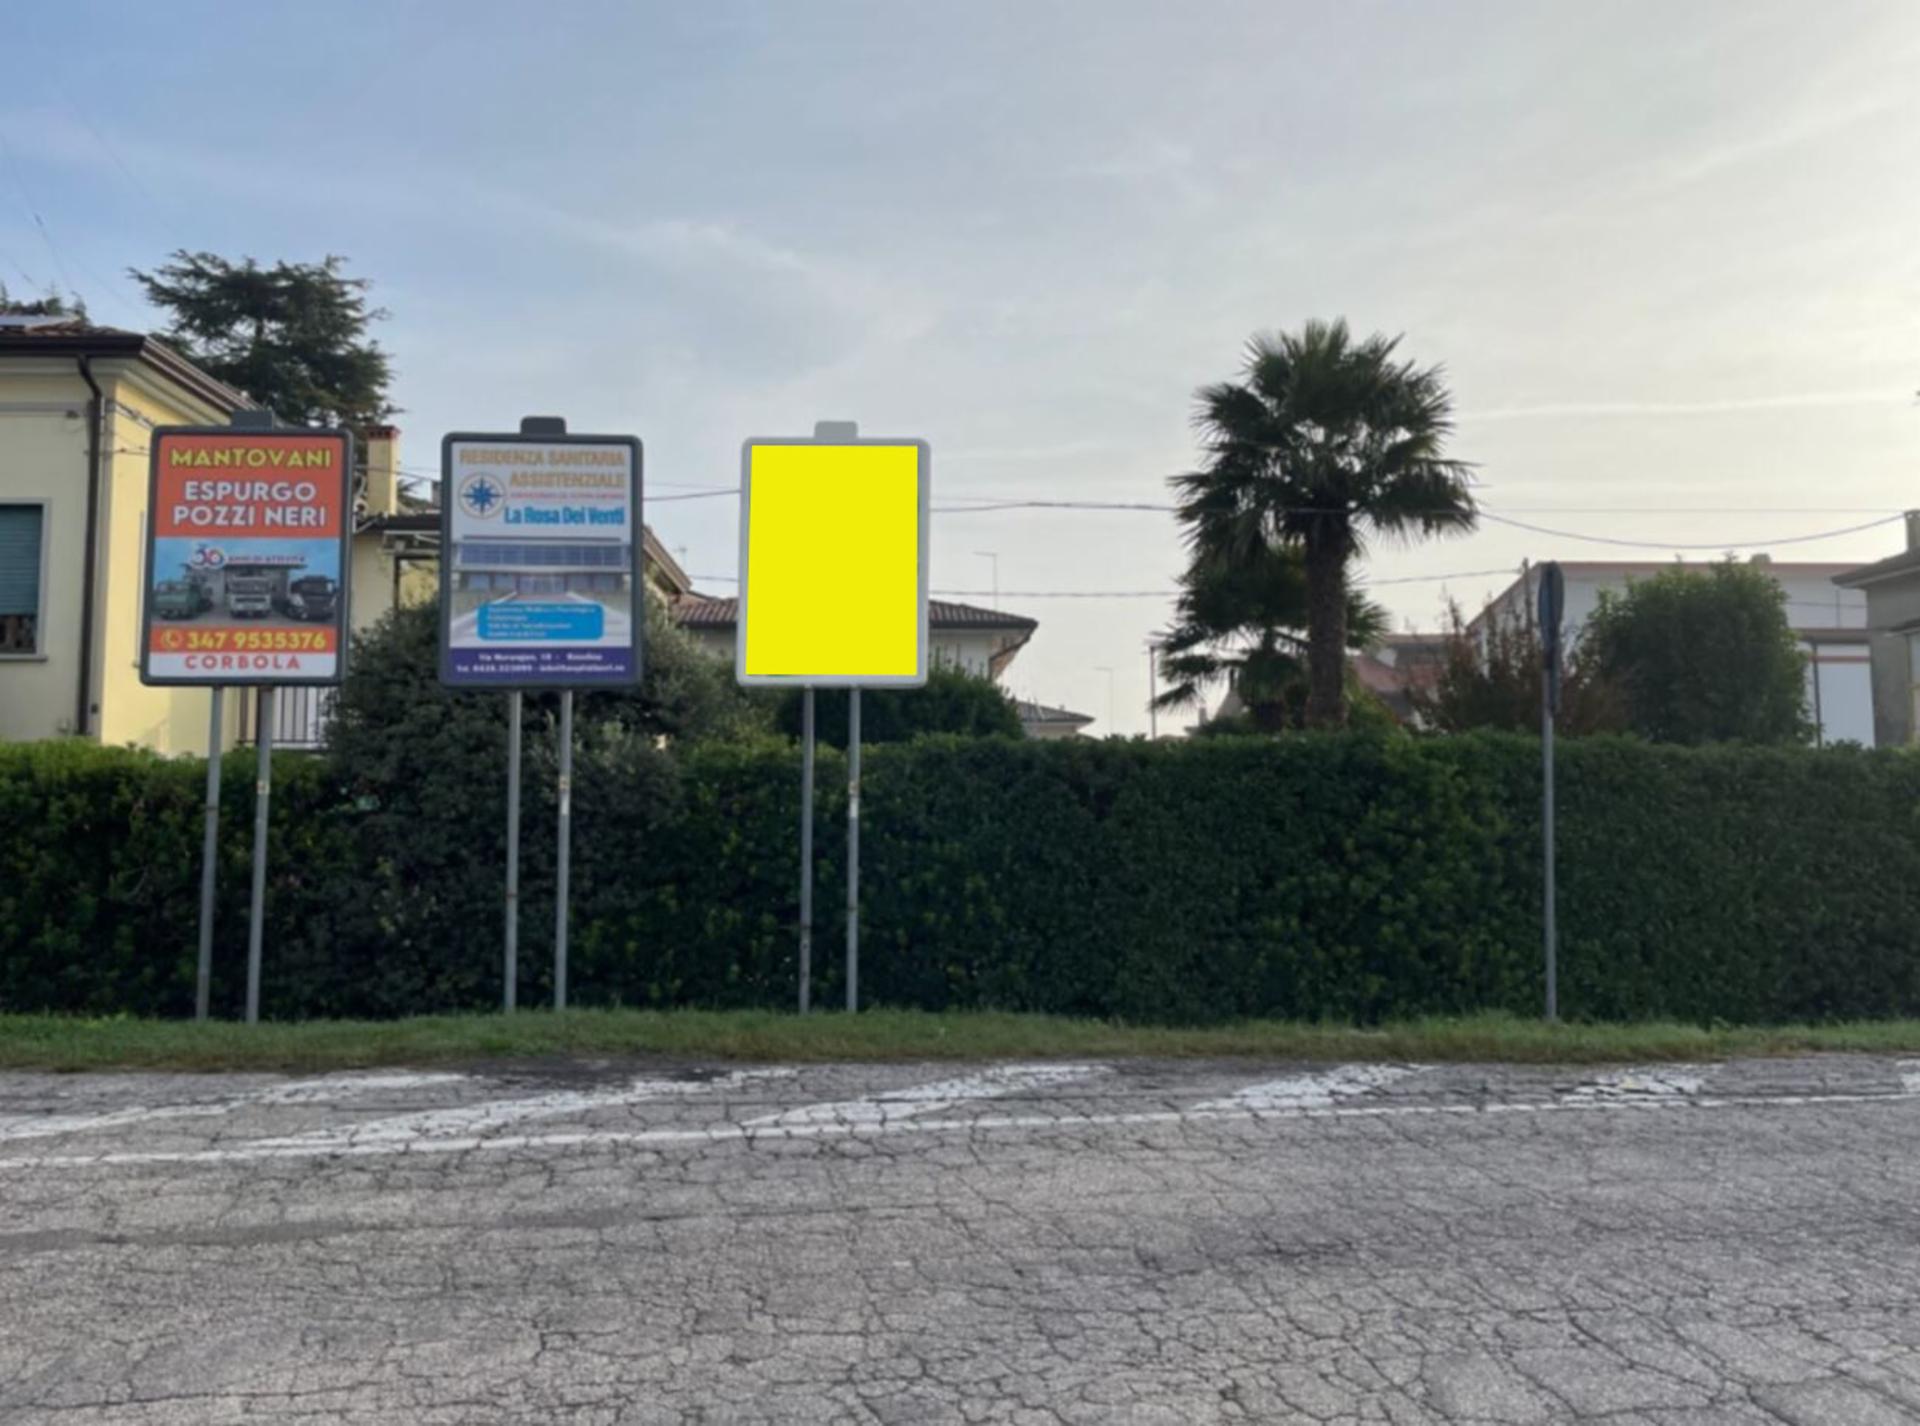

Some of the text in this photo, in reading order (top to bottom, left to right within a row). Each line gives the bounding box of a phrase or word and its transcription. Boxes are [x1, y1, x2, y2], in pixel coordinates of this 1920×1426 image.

[170, 449, 331, 467] MANTOVANI
[460, 449, 625, 466] RESIDENZA SANITARIA
[511, 472, 625, 487] ASSISTENZIALE
[184, 481, 316, 501] ESPURGO
[173, 505, 325, 526] POZZI NERI
[505, 507, 625, 524] La Rosa Dei Venti
[187, 631, 326, 649] 347 9535376
[185, 655, 300, 670] CORBOLA
